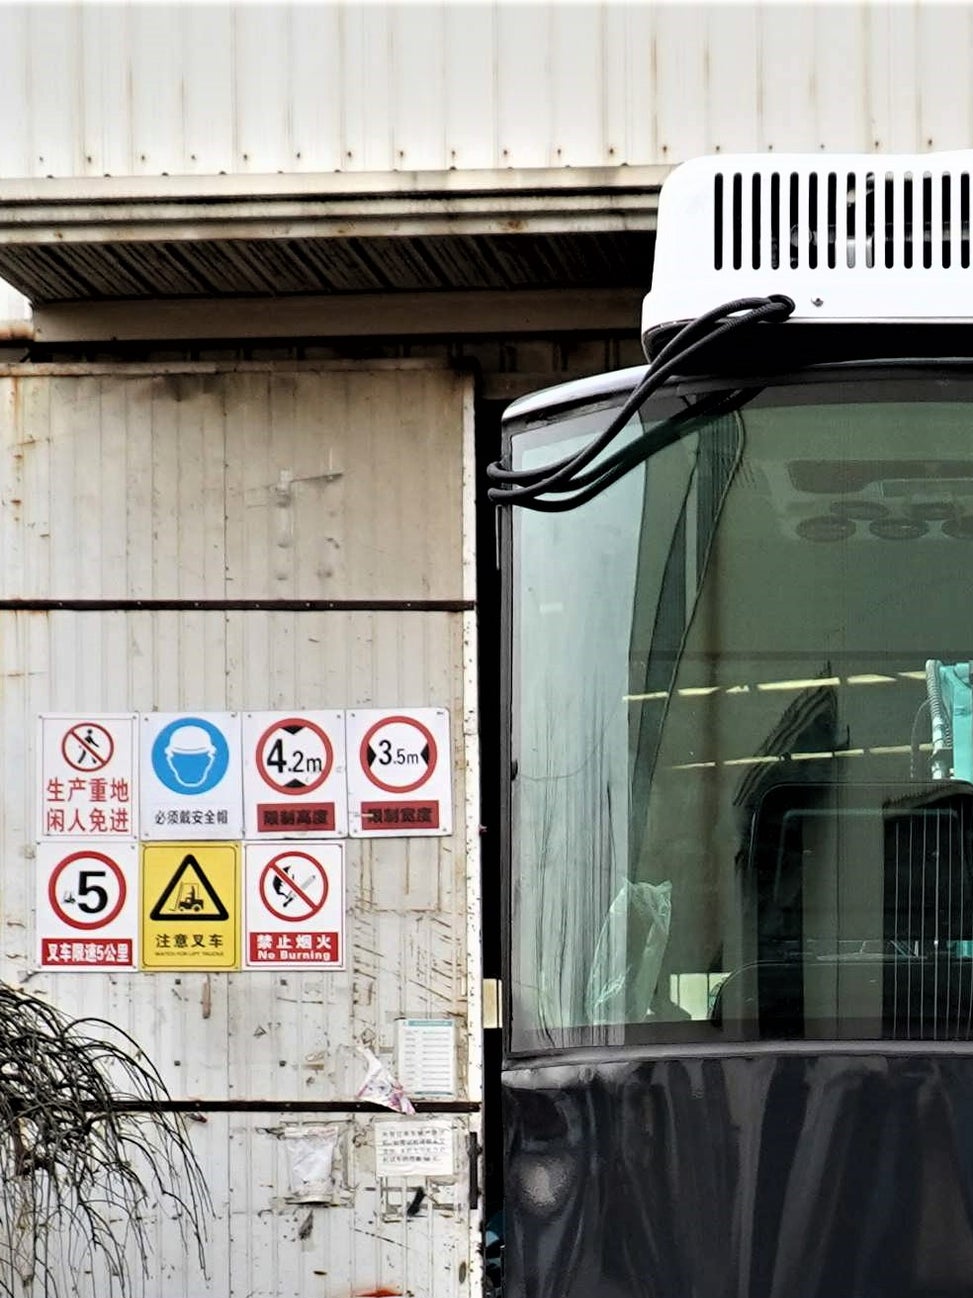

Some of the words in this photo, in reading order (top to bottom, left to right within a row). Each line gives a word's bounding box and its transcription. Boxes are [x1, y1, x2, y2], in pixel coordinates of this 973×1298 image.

[266, 738, 322, 773] 4.2m
[378, 739, 419, 766] 3.5m
[47, 777, 129, 802] 生产重地
[47, 808, 129, 833] 闲人免进
[154, 809, 229, 825] 必须戴安全帽
[77, 870, 108, 914] 5
[47, 942, 129, 963] 叉车限速5公里
[155, 933, 224, 949] 注意叉车
[256, 934, 332, 950] 禁止烟火
[257, 950, 276, 961] No
[280, 950, 331, 961] Burning
